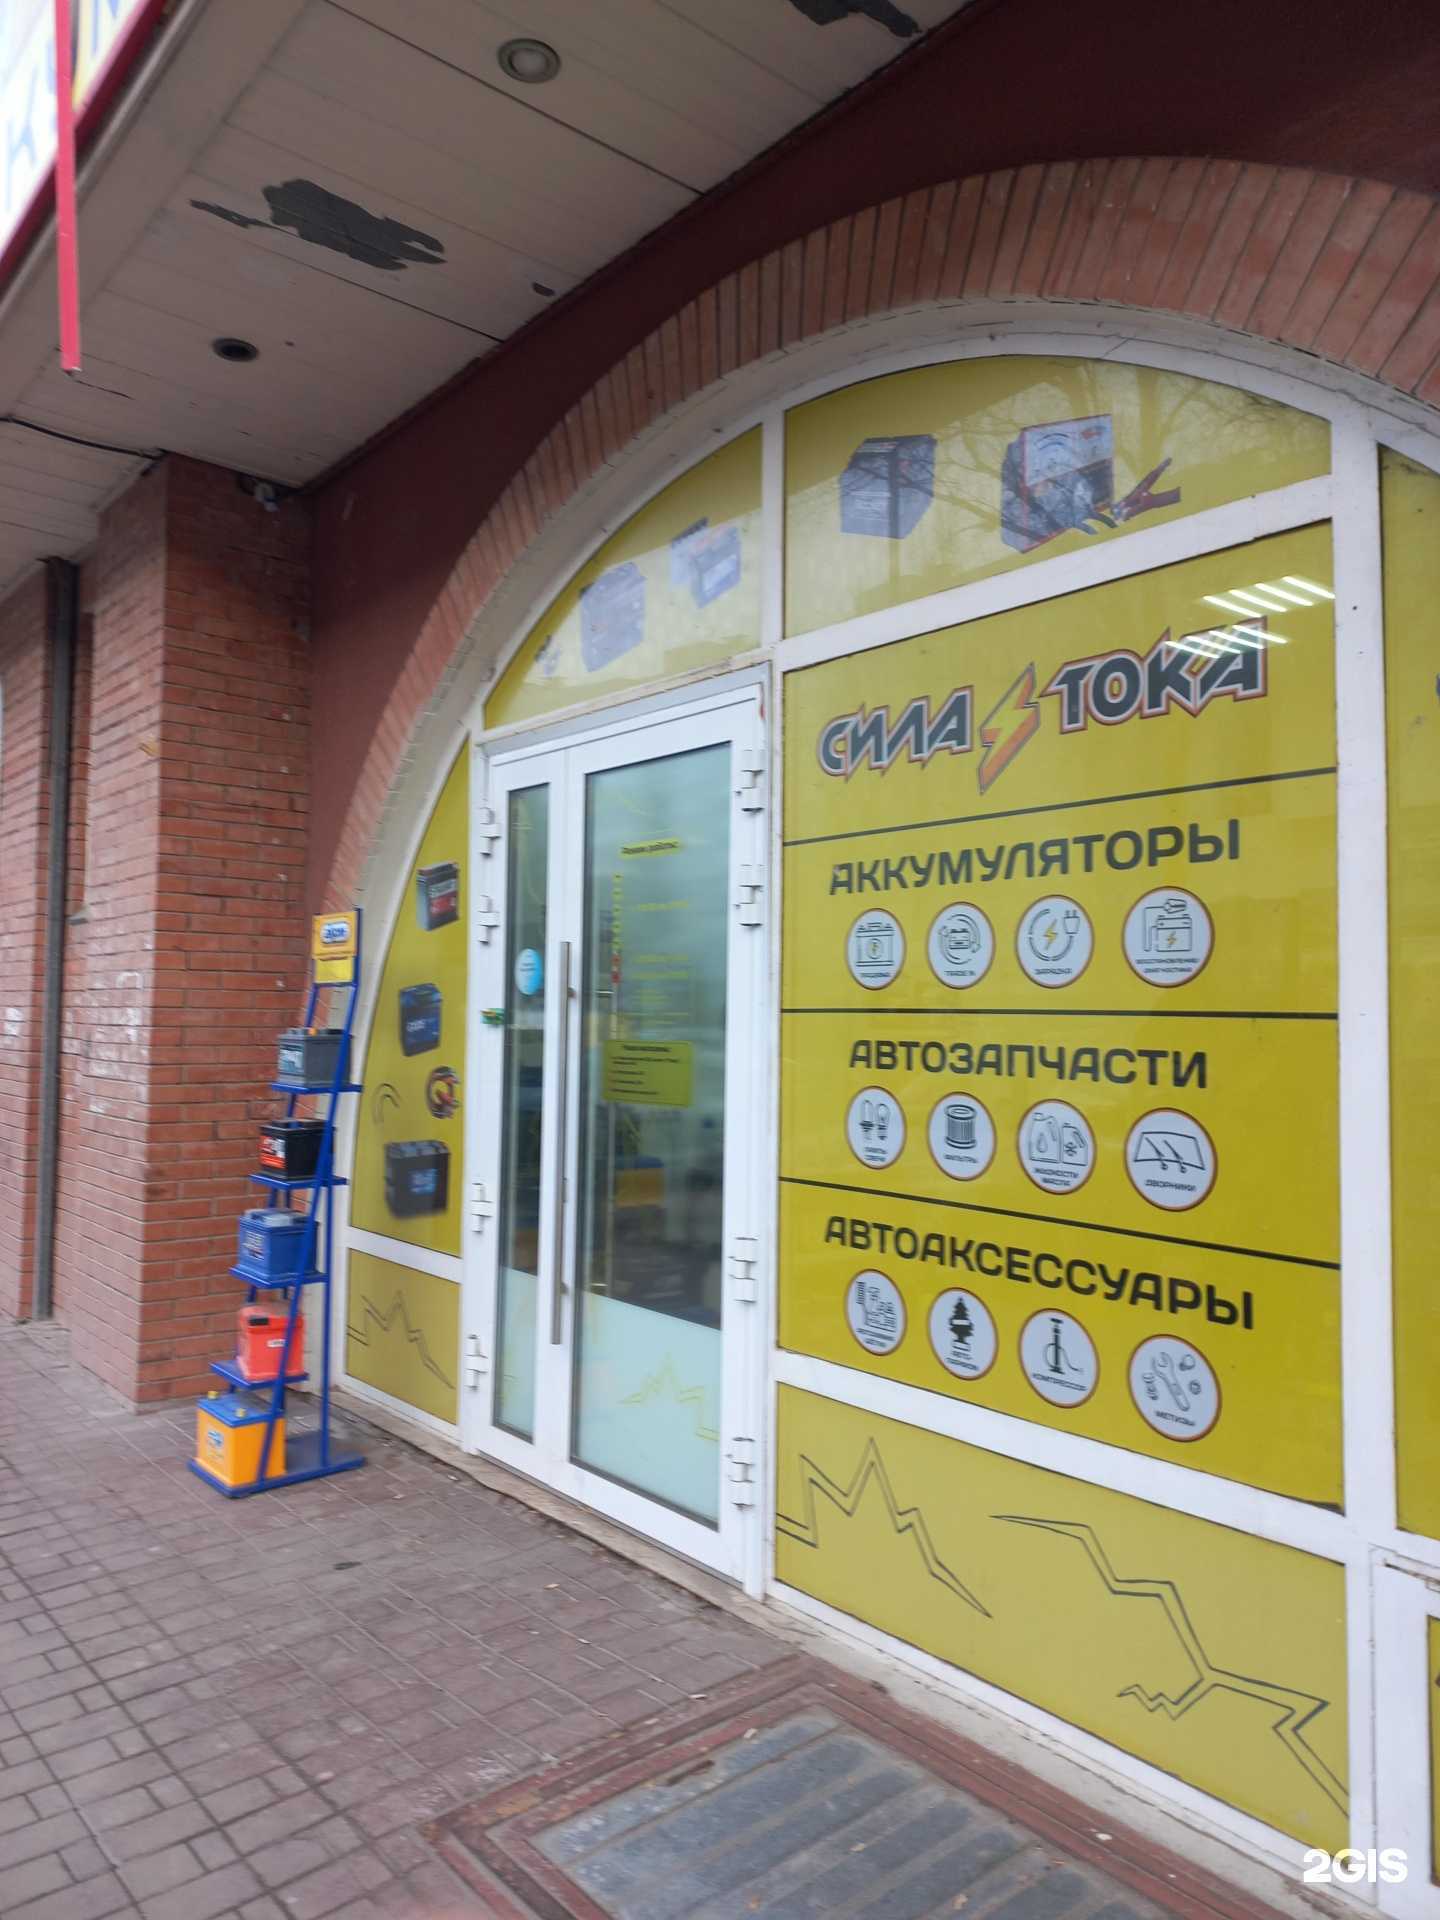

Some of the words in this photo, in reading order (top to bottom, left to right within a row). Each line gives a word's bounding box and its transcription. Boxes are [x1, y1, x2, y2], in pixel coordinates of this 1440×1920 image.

[818, 685, 973, 782] СИЛА
[1039, 616, 1267, 733] ТОКА
[829, 819, 1239, 895] АККУМУЛЯТОРЫ
[850, 1039, 1207, 1089] АВТОЗАПЧАСТИ
[1144, 1178, 1197, 1192] ДВОРНИКИ
[825, 1215, 1253, 1330] АВТОАКСЕССУАРЫ
